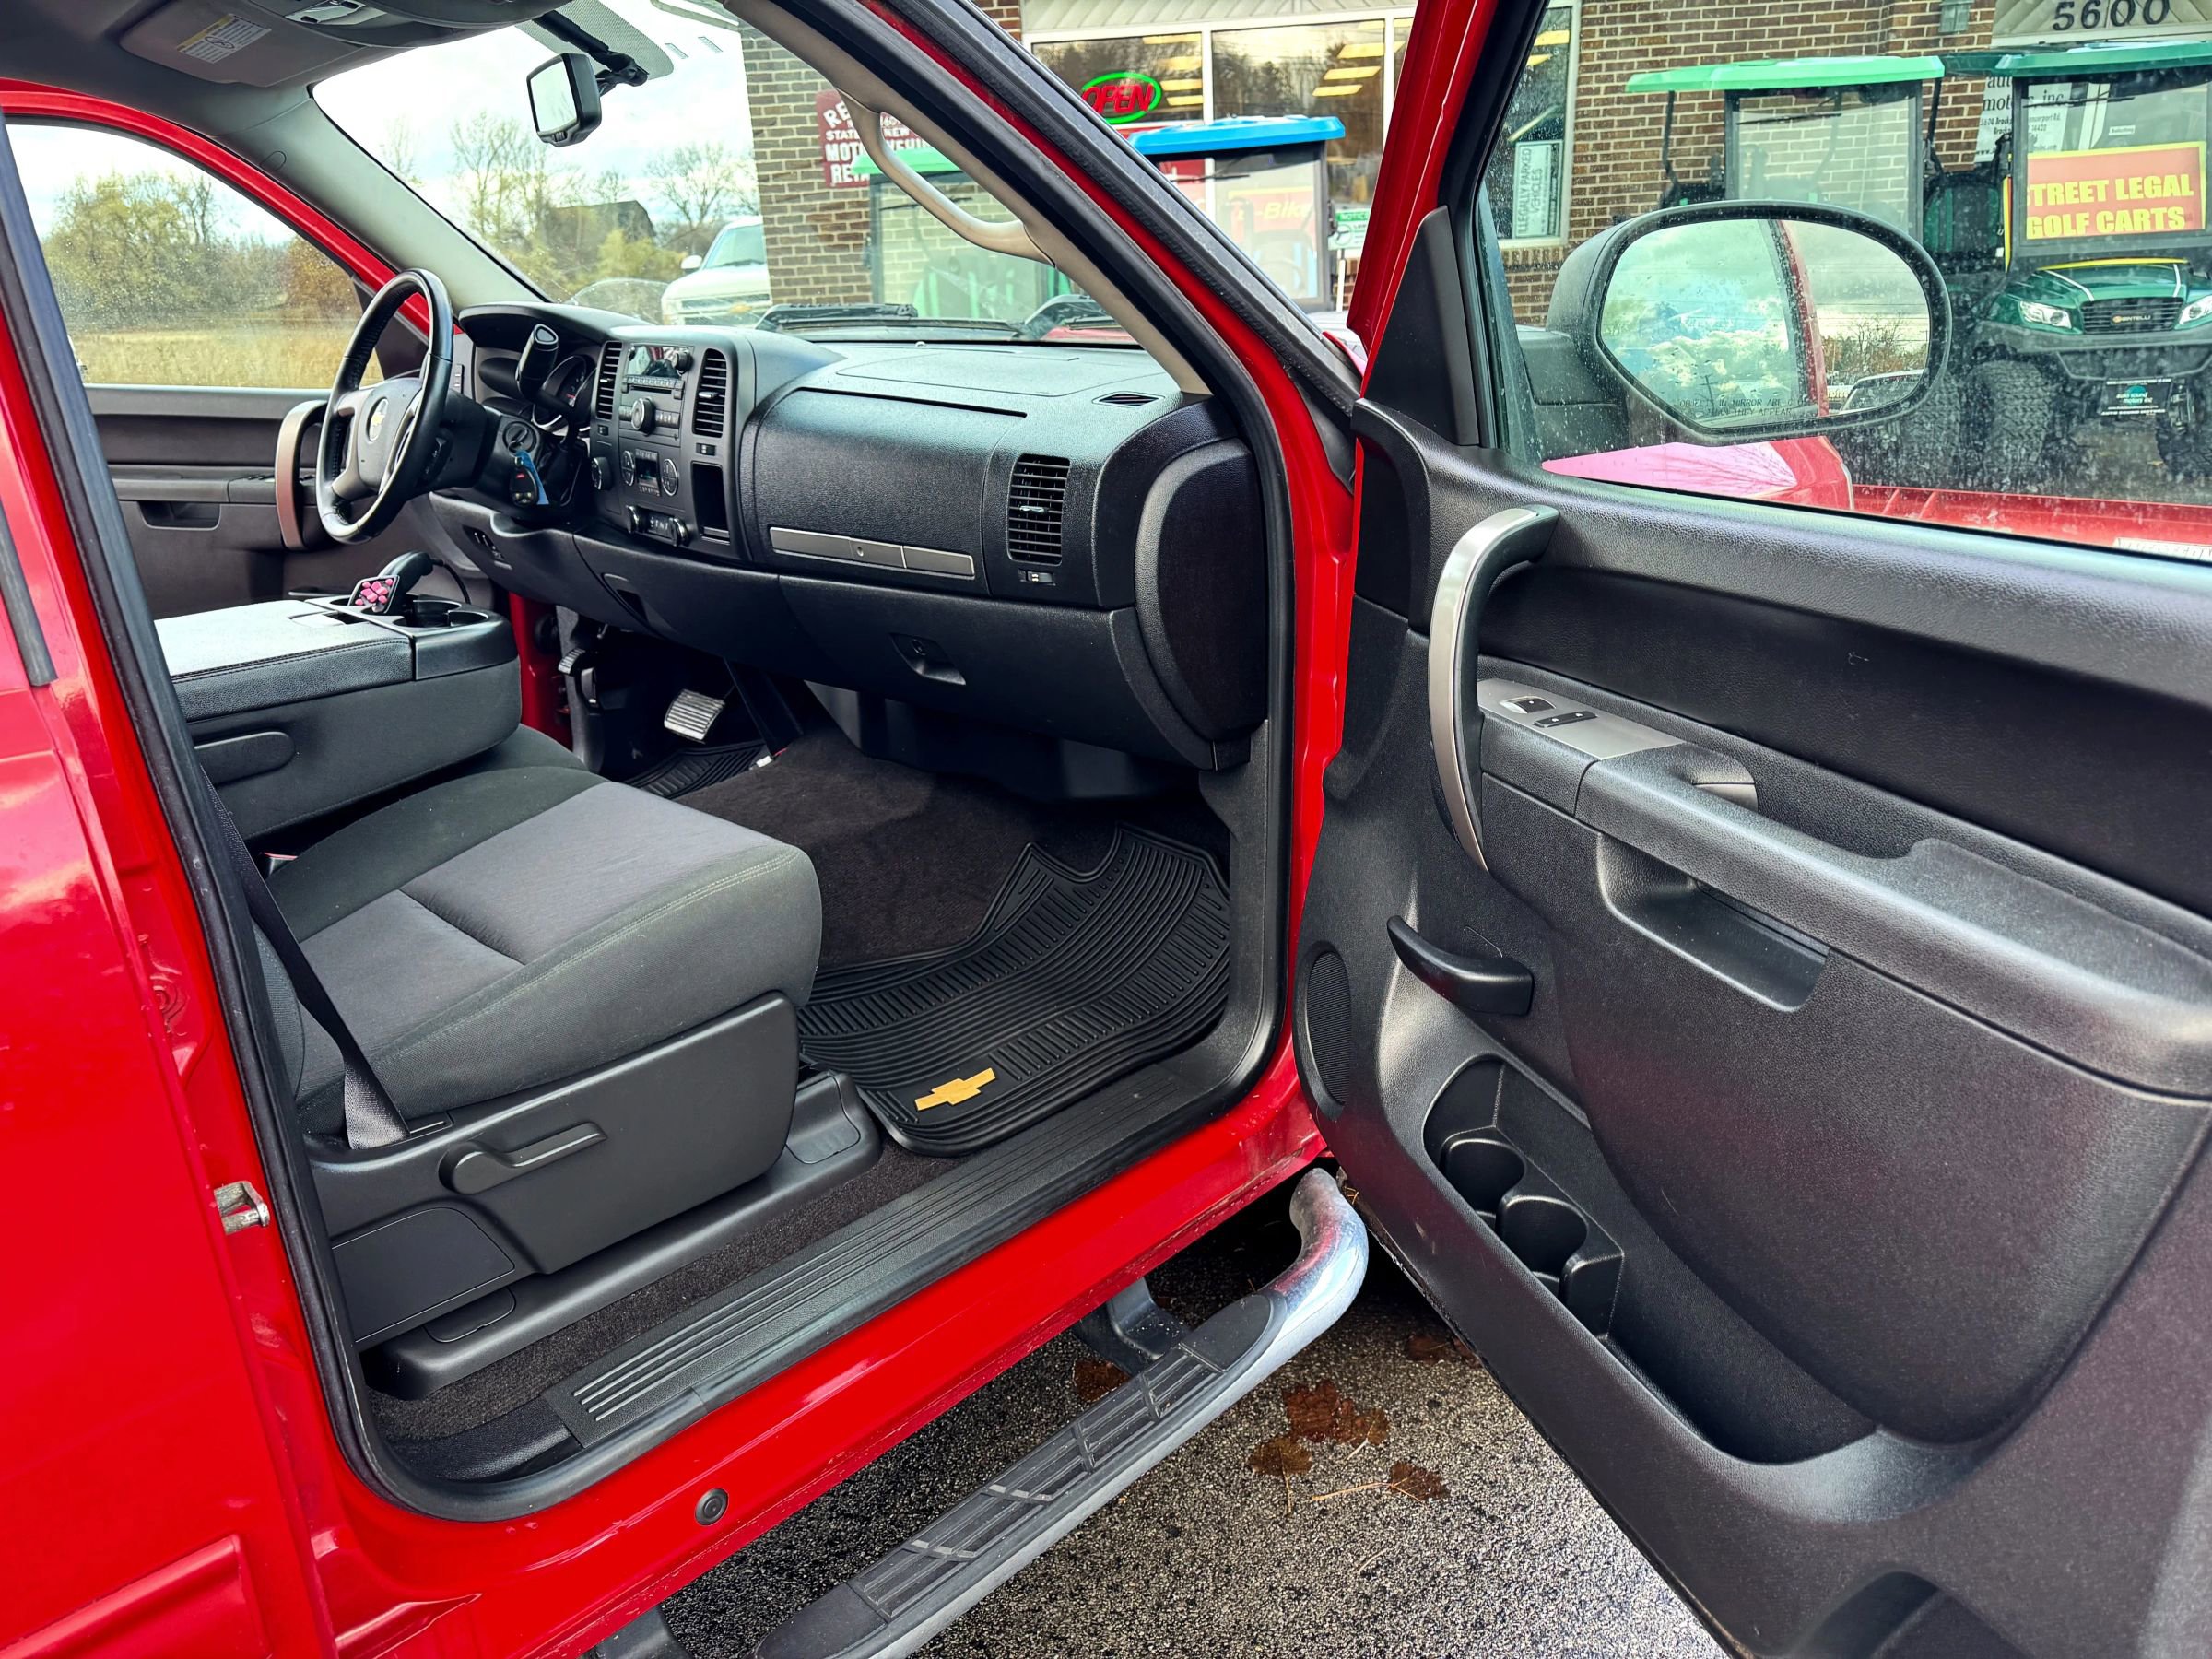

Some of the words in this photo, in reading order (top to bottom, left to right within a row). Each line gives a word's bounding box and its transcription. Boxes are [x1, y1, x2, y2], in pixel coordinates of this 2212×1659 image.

[2053, 0, 2170, 30] 5600
[1081, 83, 1154, 114] OPEN
[884, 127, 910, 137] NEW
[825, 140, 865, 161] MOT
[2028, 180, 2109, 206] TREET
[2115, 174, 2194, 200] LEGAL
[2028, 212, 2089, 239] GOLF
[2096, 206, 2185, 234] CARTS
[1719, 398, 1728, 406] IN
[1732, 398, 1763, 407] MIRROR
